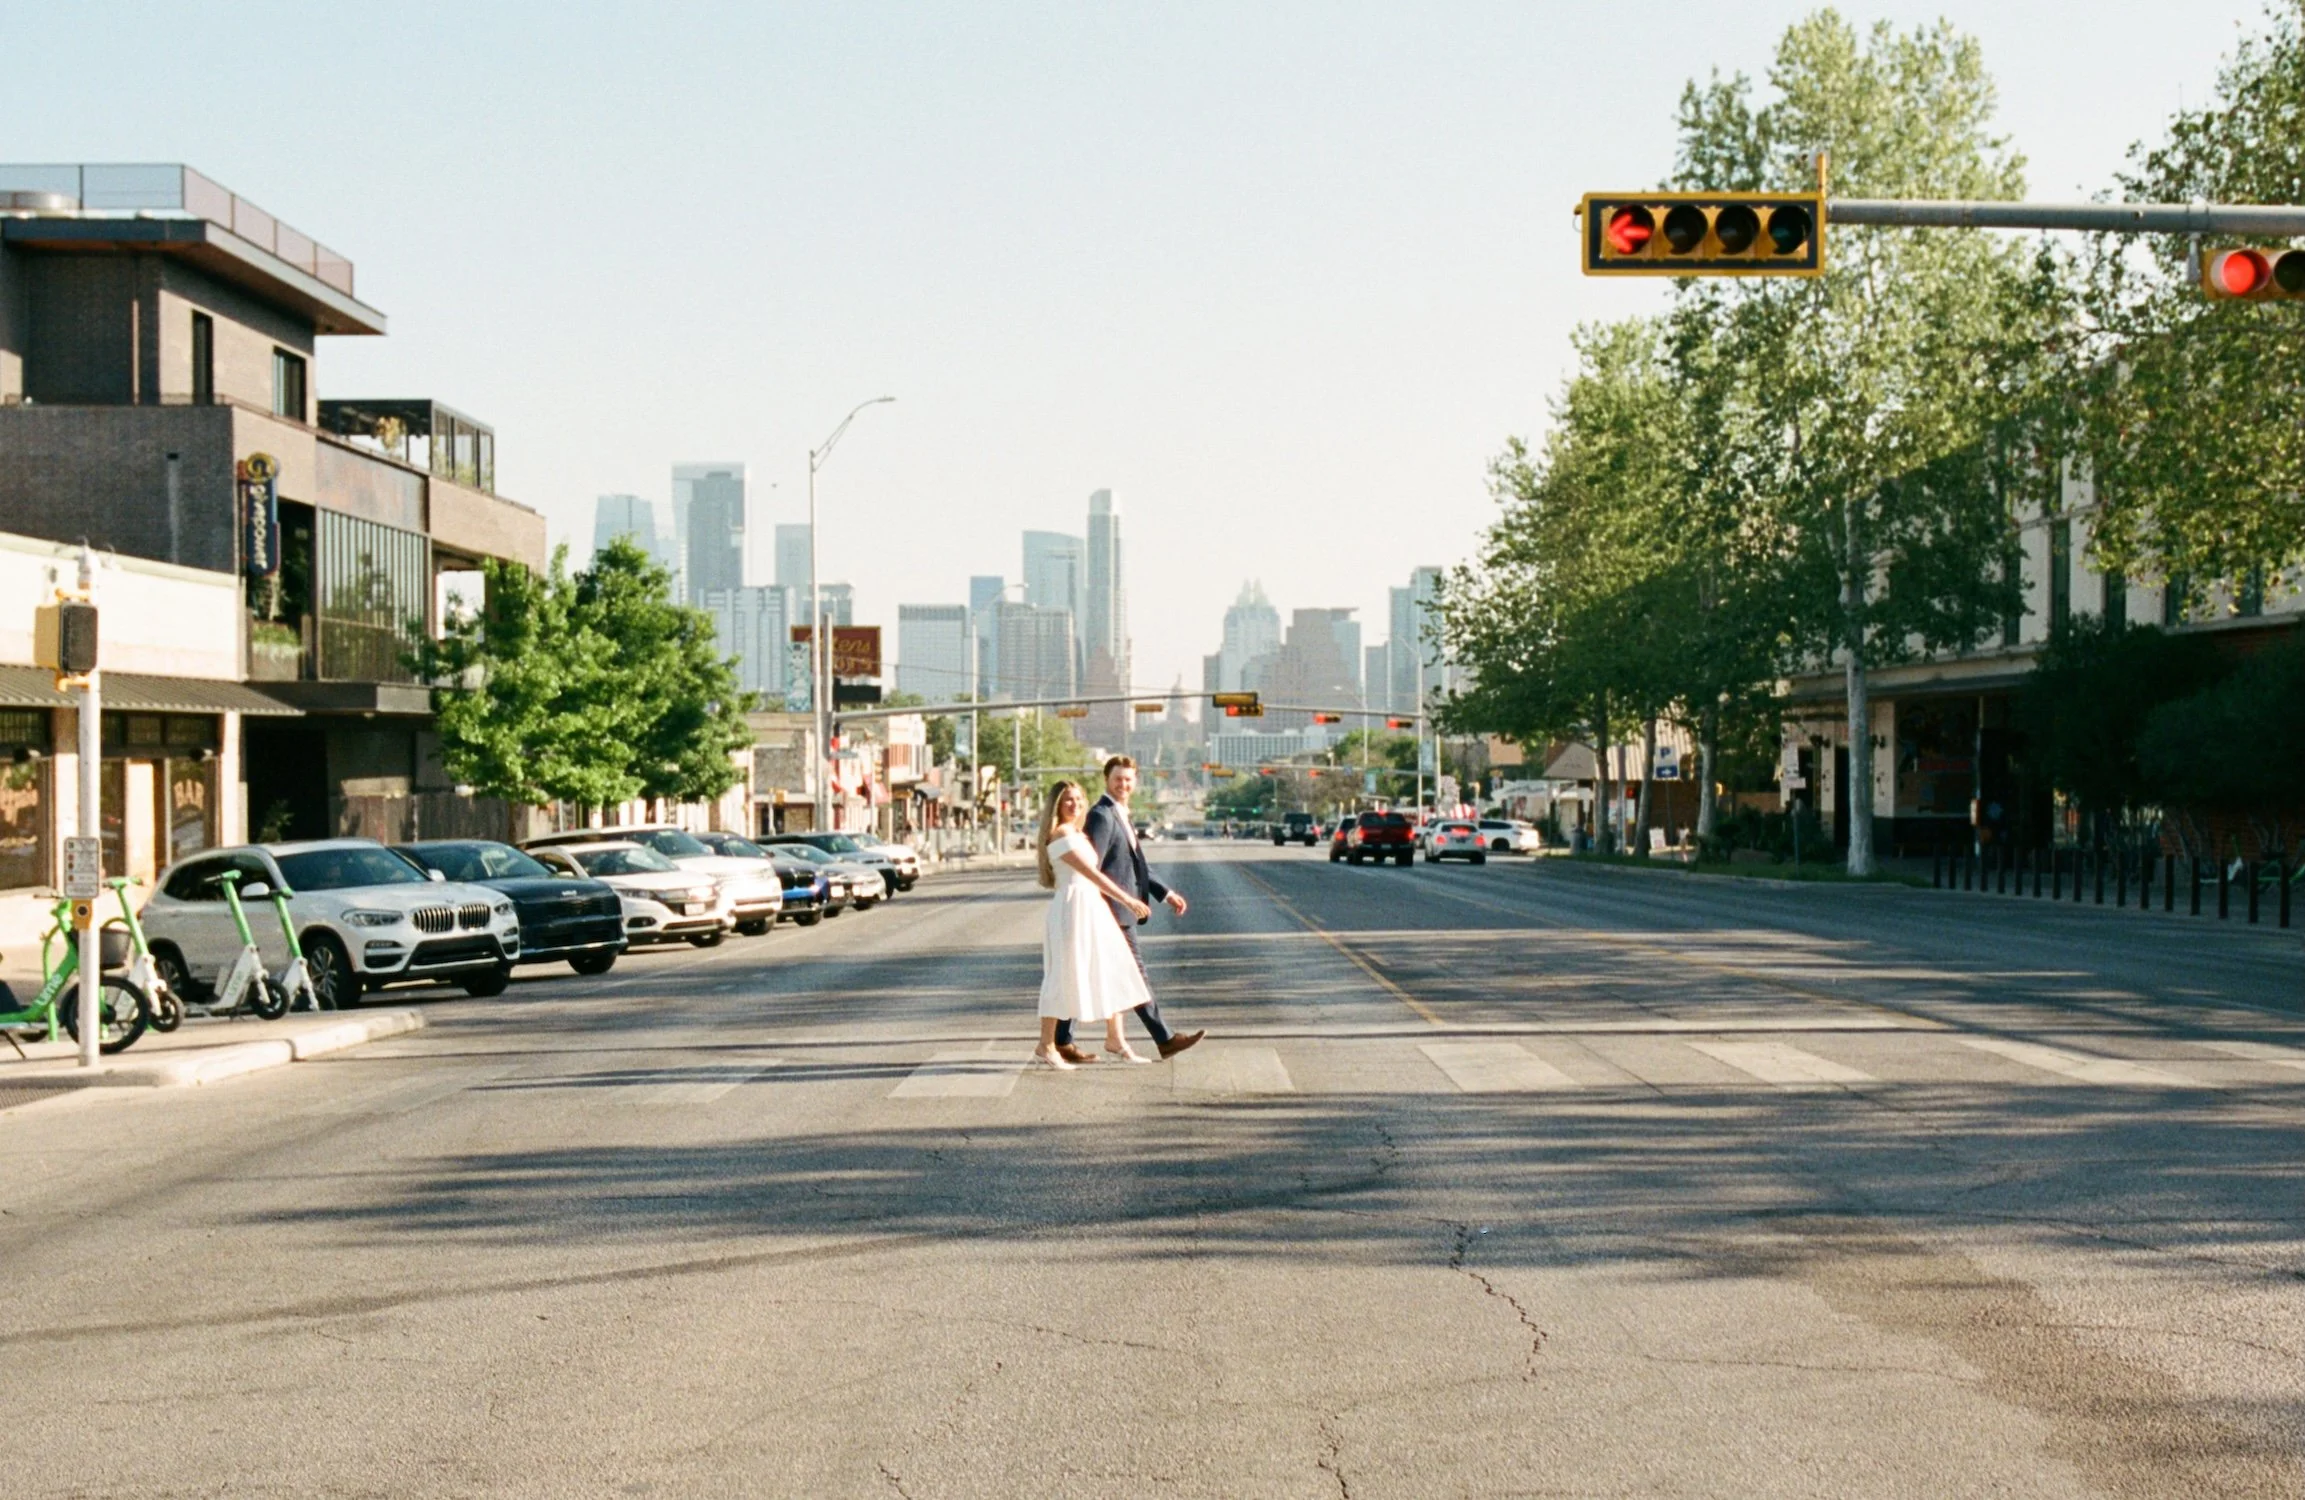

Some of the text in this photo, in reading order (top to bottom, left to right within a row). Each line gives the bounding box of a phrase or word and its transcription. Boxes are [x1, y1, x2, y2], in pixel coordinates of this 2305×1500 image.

[1660, 746, 1671, 759] P
[174, 778, 204, 810] BAR
[34, 972, 63, 1006] Lime
